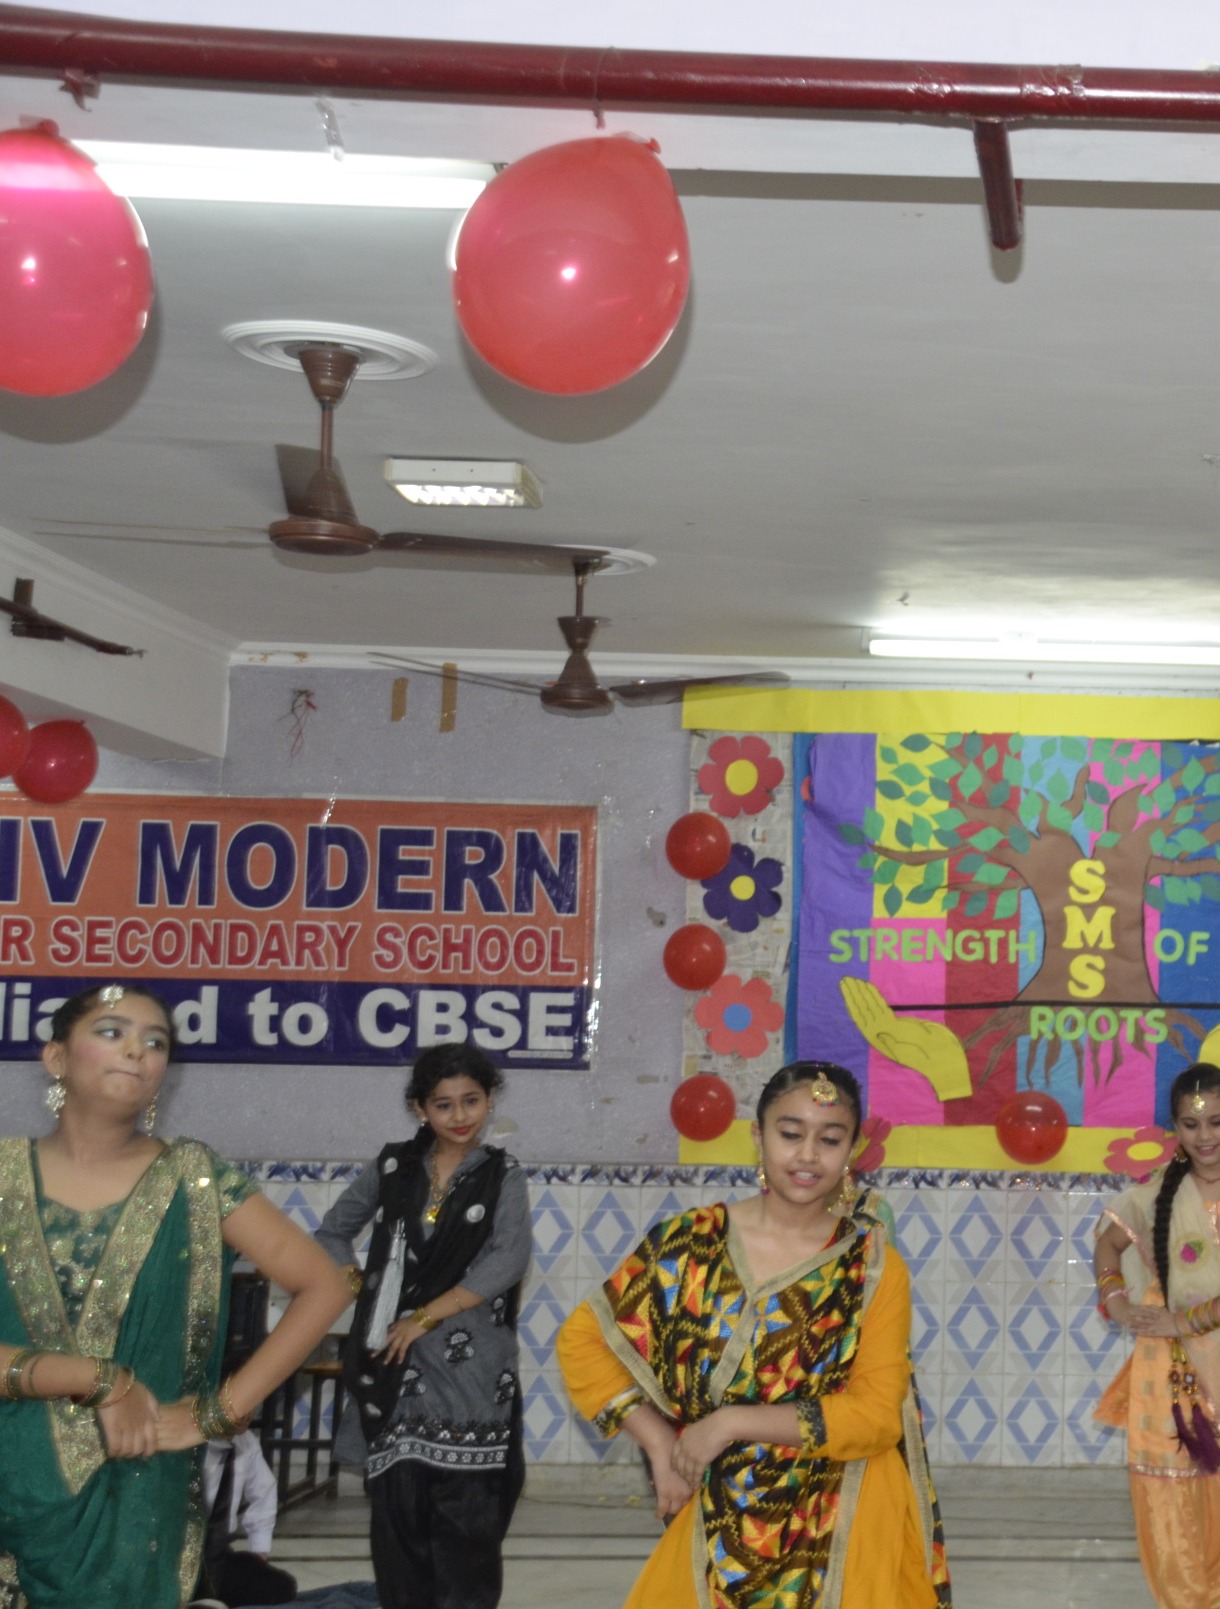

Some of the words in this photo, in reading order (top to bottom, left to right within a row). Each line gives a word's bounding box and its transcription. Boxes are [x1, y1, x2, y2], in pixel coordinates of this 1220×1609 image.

[136, 819, 580, 915] MODERN
[50, 915, 361, 971] SECONDARY
[372, 922, 577, 975] SCHOOL
[829, 929, 1037, 964] STRENGTH
[1153, 929, 1210, 965] OF
[248, 987, 329, 1046] to
[358, 988, 576, 1050] CBSE
[1030, 1005, 1168, 1043] ROOTS
